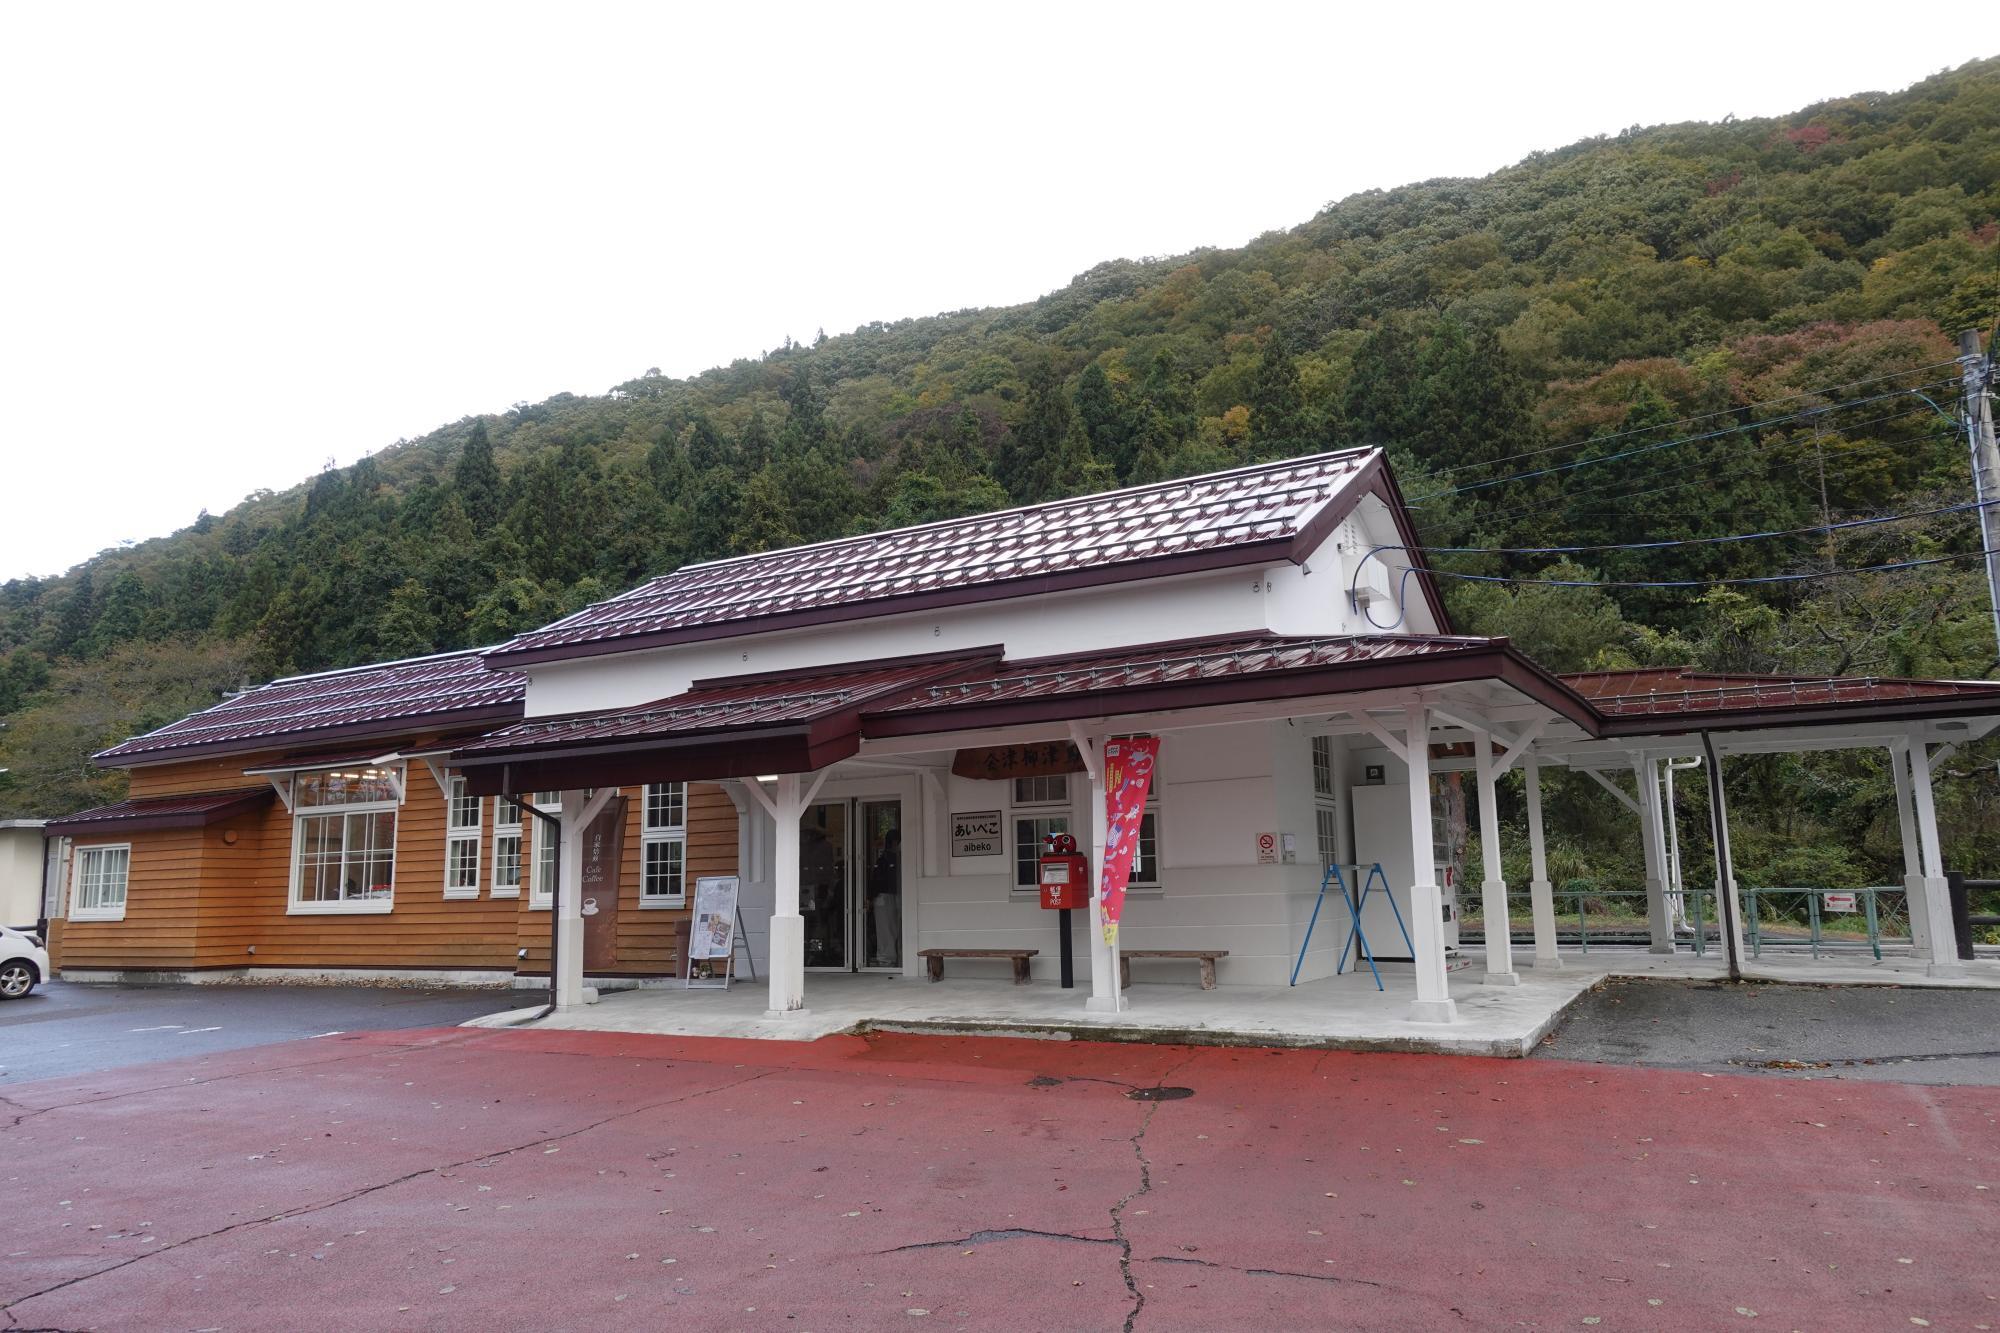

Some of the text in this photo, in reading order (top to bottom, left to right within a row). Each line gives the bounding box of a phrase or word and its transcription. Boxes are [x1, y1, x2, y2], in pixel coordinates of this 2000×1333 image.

[954, 822, 999, 837] あいべこ
[963, 842, 992, 852] aibeko
[582, 875, 603, 883] Coffee
